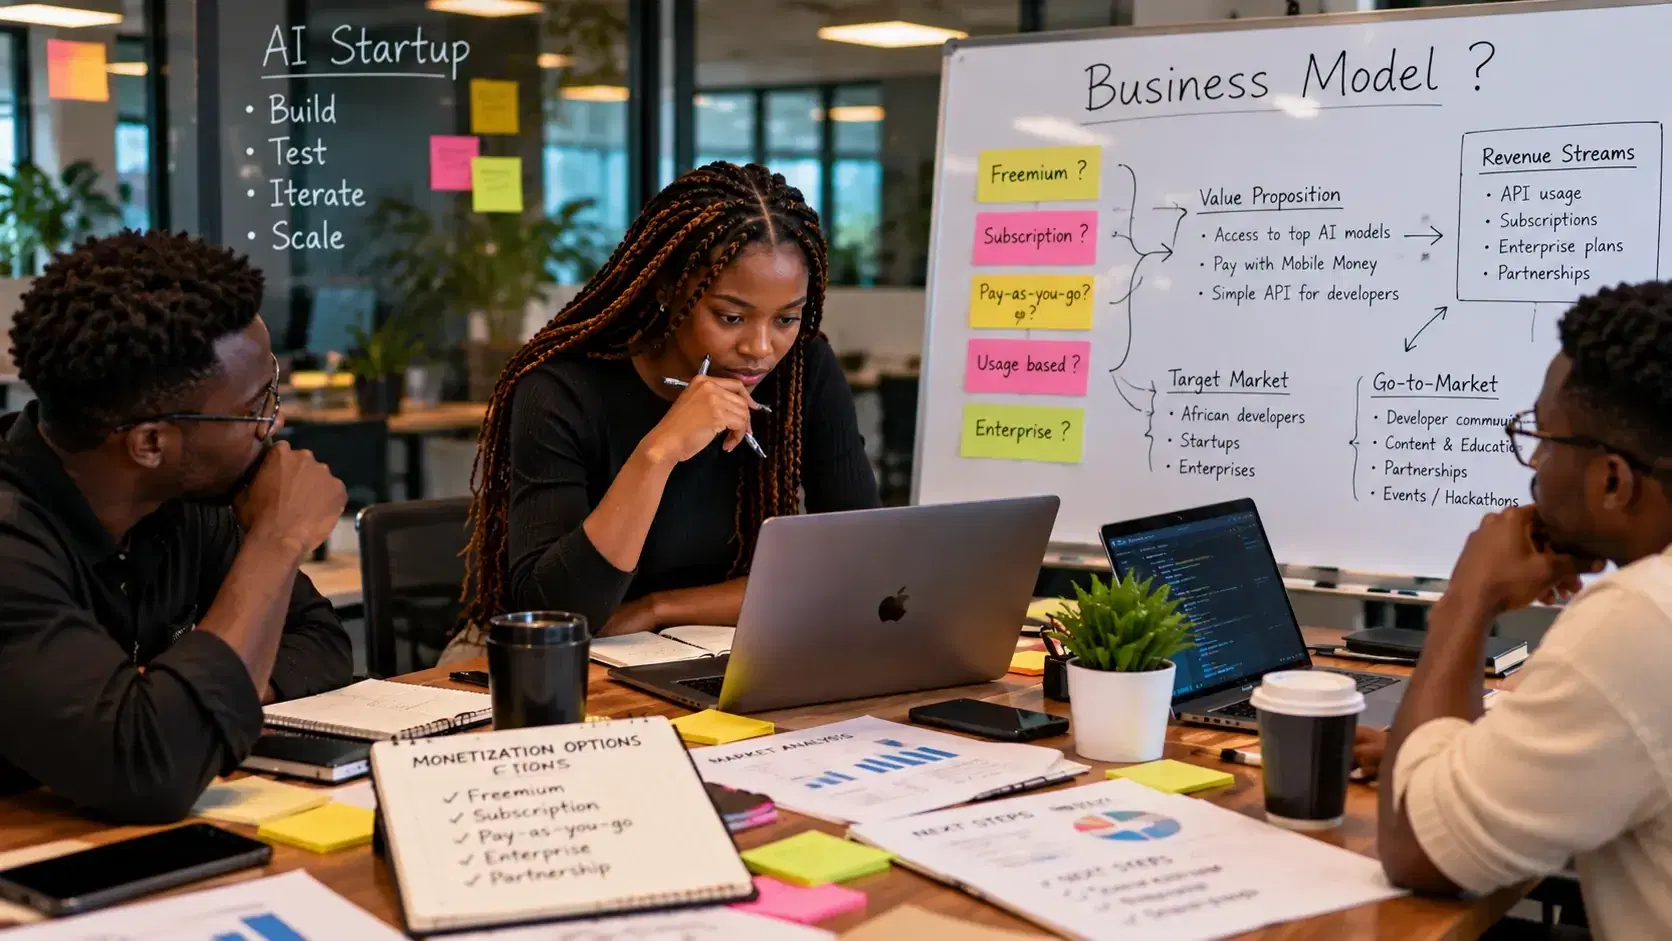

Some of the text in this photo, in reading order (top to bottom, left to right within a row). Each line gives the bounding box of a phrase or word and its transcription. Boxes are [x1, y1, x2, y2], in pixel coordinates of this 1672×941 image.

[262, 24, 470, 80] AI Startup
[1084, 41, 1495, 111] Business Model ?
[269, 93, 337, 124] Build
[268, 136, 327, 165] Test
[1482, 144, 1635, 167] Revenue Streams
[991, 159, 1088, 184] Freemium ?
[269, 178, 366, 207] Iterate
[1199, 186, 1341, 211] Value Proposition
[1500, 185, 1582, 206] API usage
[1500, 212, 1598, 232] Subscriptions
[272, 220, 345, 250] Scale
[984, 223, 1090, 250] Subscription ?
[1214, 223, 1391, 246] Access to top AI models
[1499, 237, 1624, 259] Enterprise plans
[1213, 254, 1378, 277] Pay with Mobile Money
[1498, 265, 1591, 286] Partnerships
[979, 283, 1091, 306] Pay-as-you-go?
[1212, 284, 1400, 307] Simple API for developers
[977, 353, 1081, 377] Usage based ?
[1168, 368, 1289, 395] Target Market
[1372, 371, 1498, 393] Go-to-Market
[1181, 405, 1306, 429] African developers
[1386, 409, 1449, 431] Developer
[975, 419, 1071, 443] Enterprise ?
[1180, 432, 1240, 455] Startups
[1385, 435, 1517, 453] Content & Educatio
[1179, 458, 1256, 482] Enterprises
[1384, 460, 1468, 483] Partnerships
[1383, 486, 1427, 503] Events
[1445, 490, 1519, 508] Hackathons
[412, 734, 642, 769] MONETIZATION OPTIONS
[708, 732, 855, 765] MARKET ANALYSIS
[467, 782, 565, 804] Freemium
[473, 800, 600, 824] Subscription
[478, 818, 634, 846] Pay-as-you-go
[485, 841, 591, 867] Enterprise
[489, 860, 613, 886] Partnership
